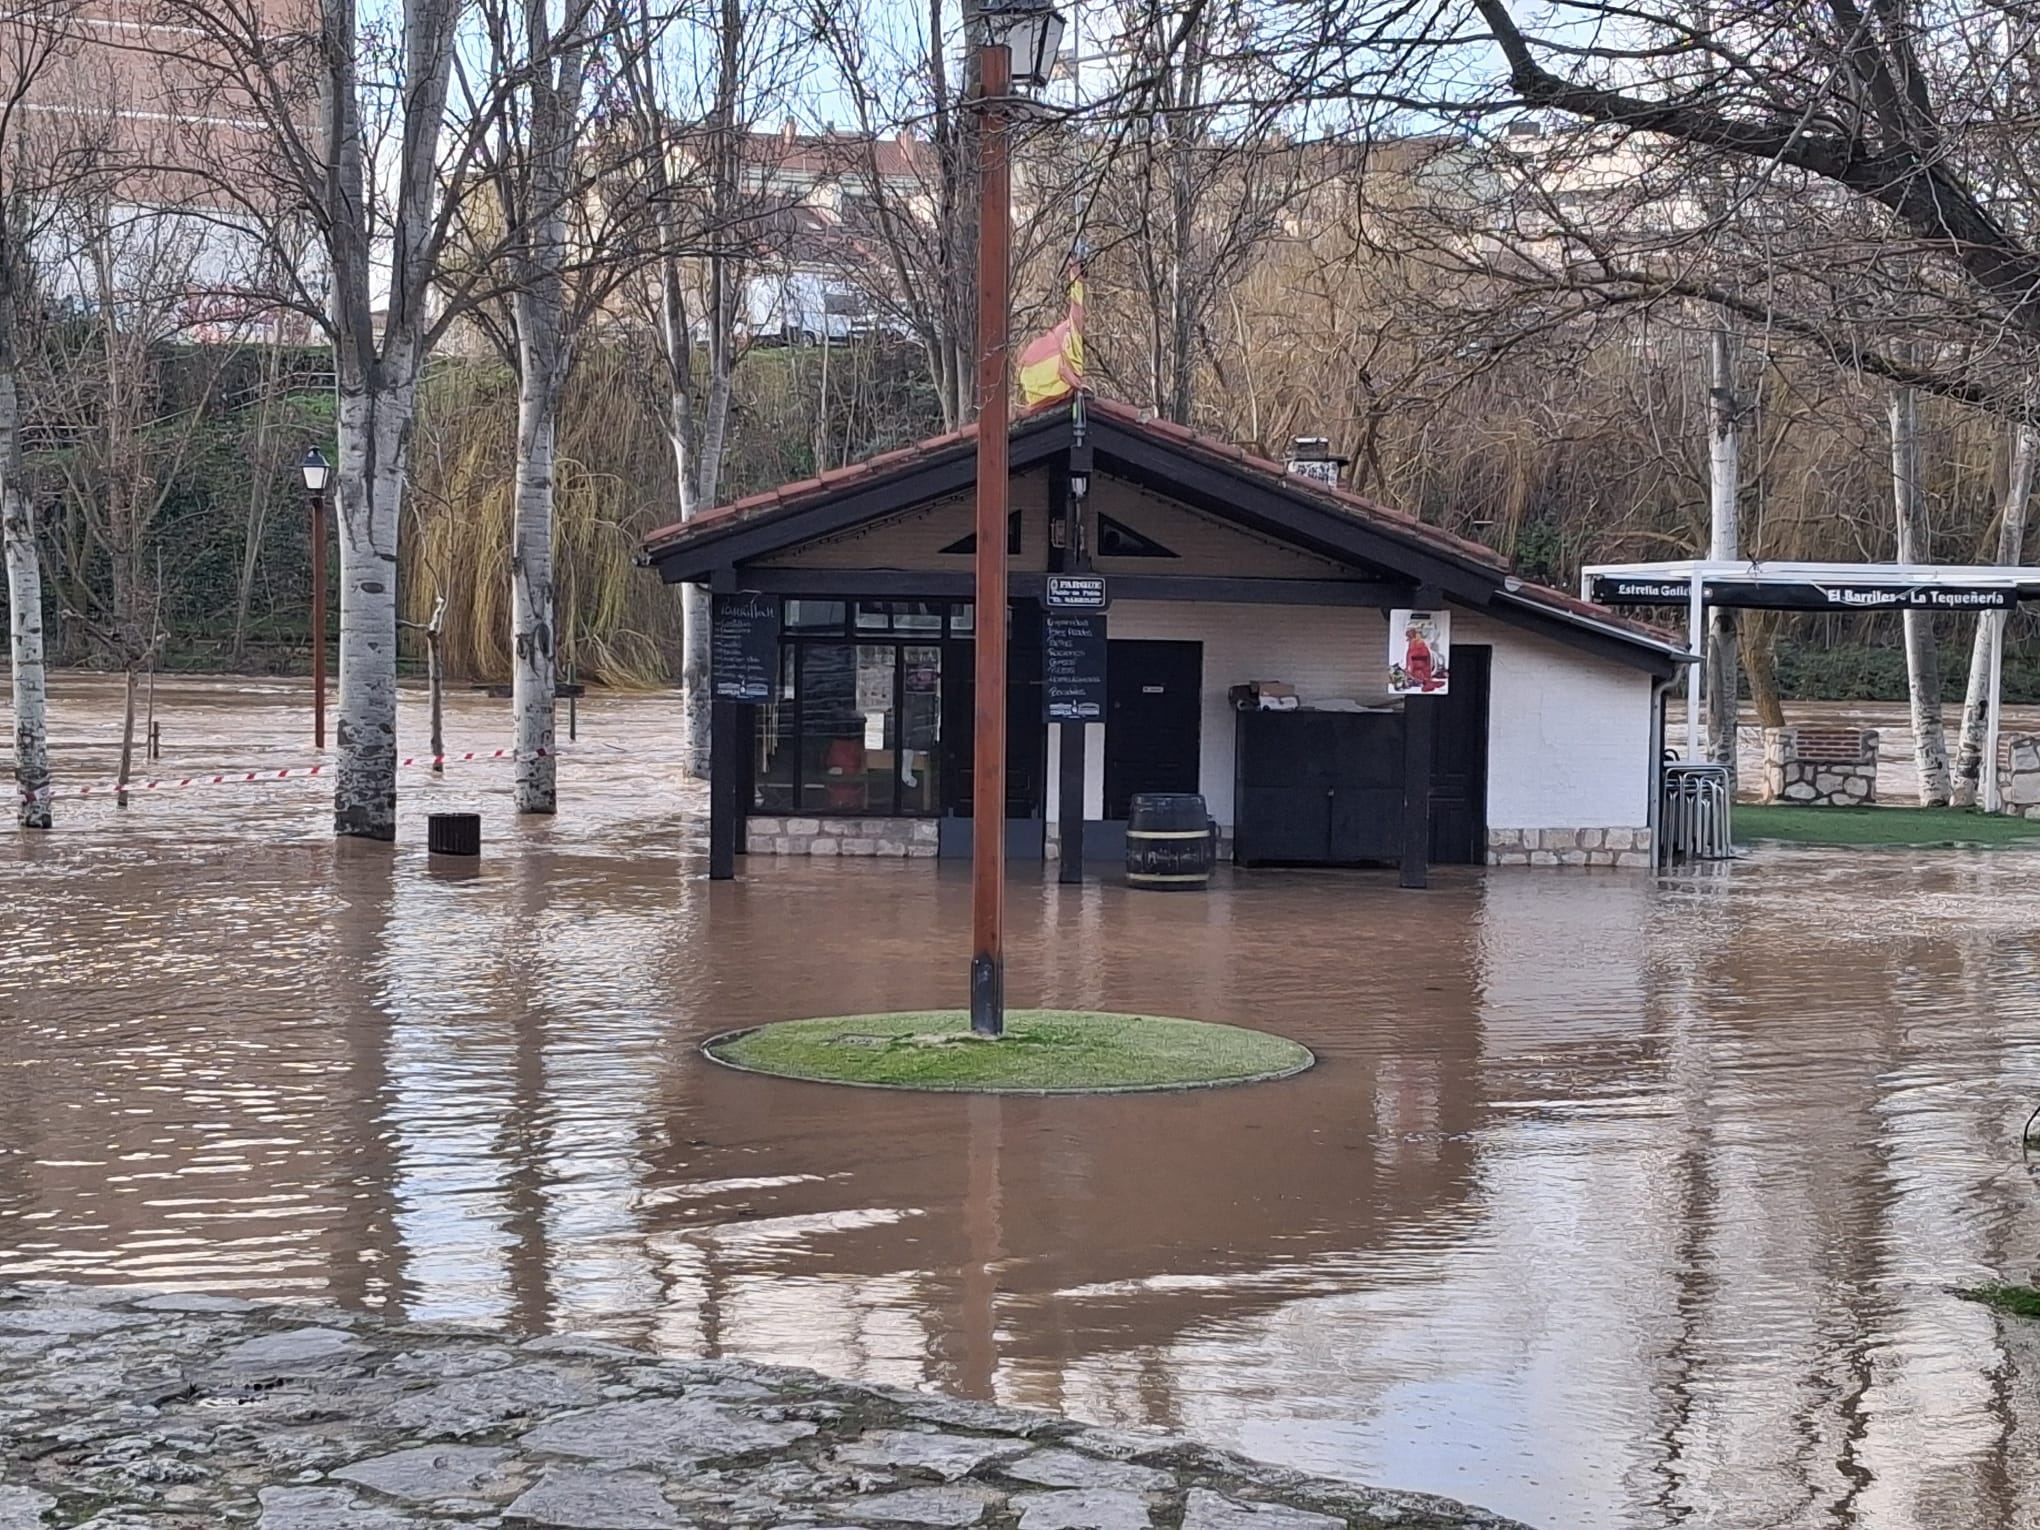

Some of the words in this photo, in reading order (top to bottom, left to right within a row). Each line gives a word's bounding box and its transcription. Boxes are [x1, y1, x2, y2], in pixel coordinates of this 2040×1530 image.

[1618, 584, 1659, 595] Estrella
[1827, 589, 1841, 602] El
[1844, 589, 1897, 604] Barriles
[1910, 591, 1927, 604] La
[1929, 591, 2005, 607] Tequeñería
